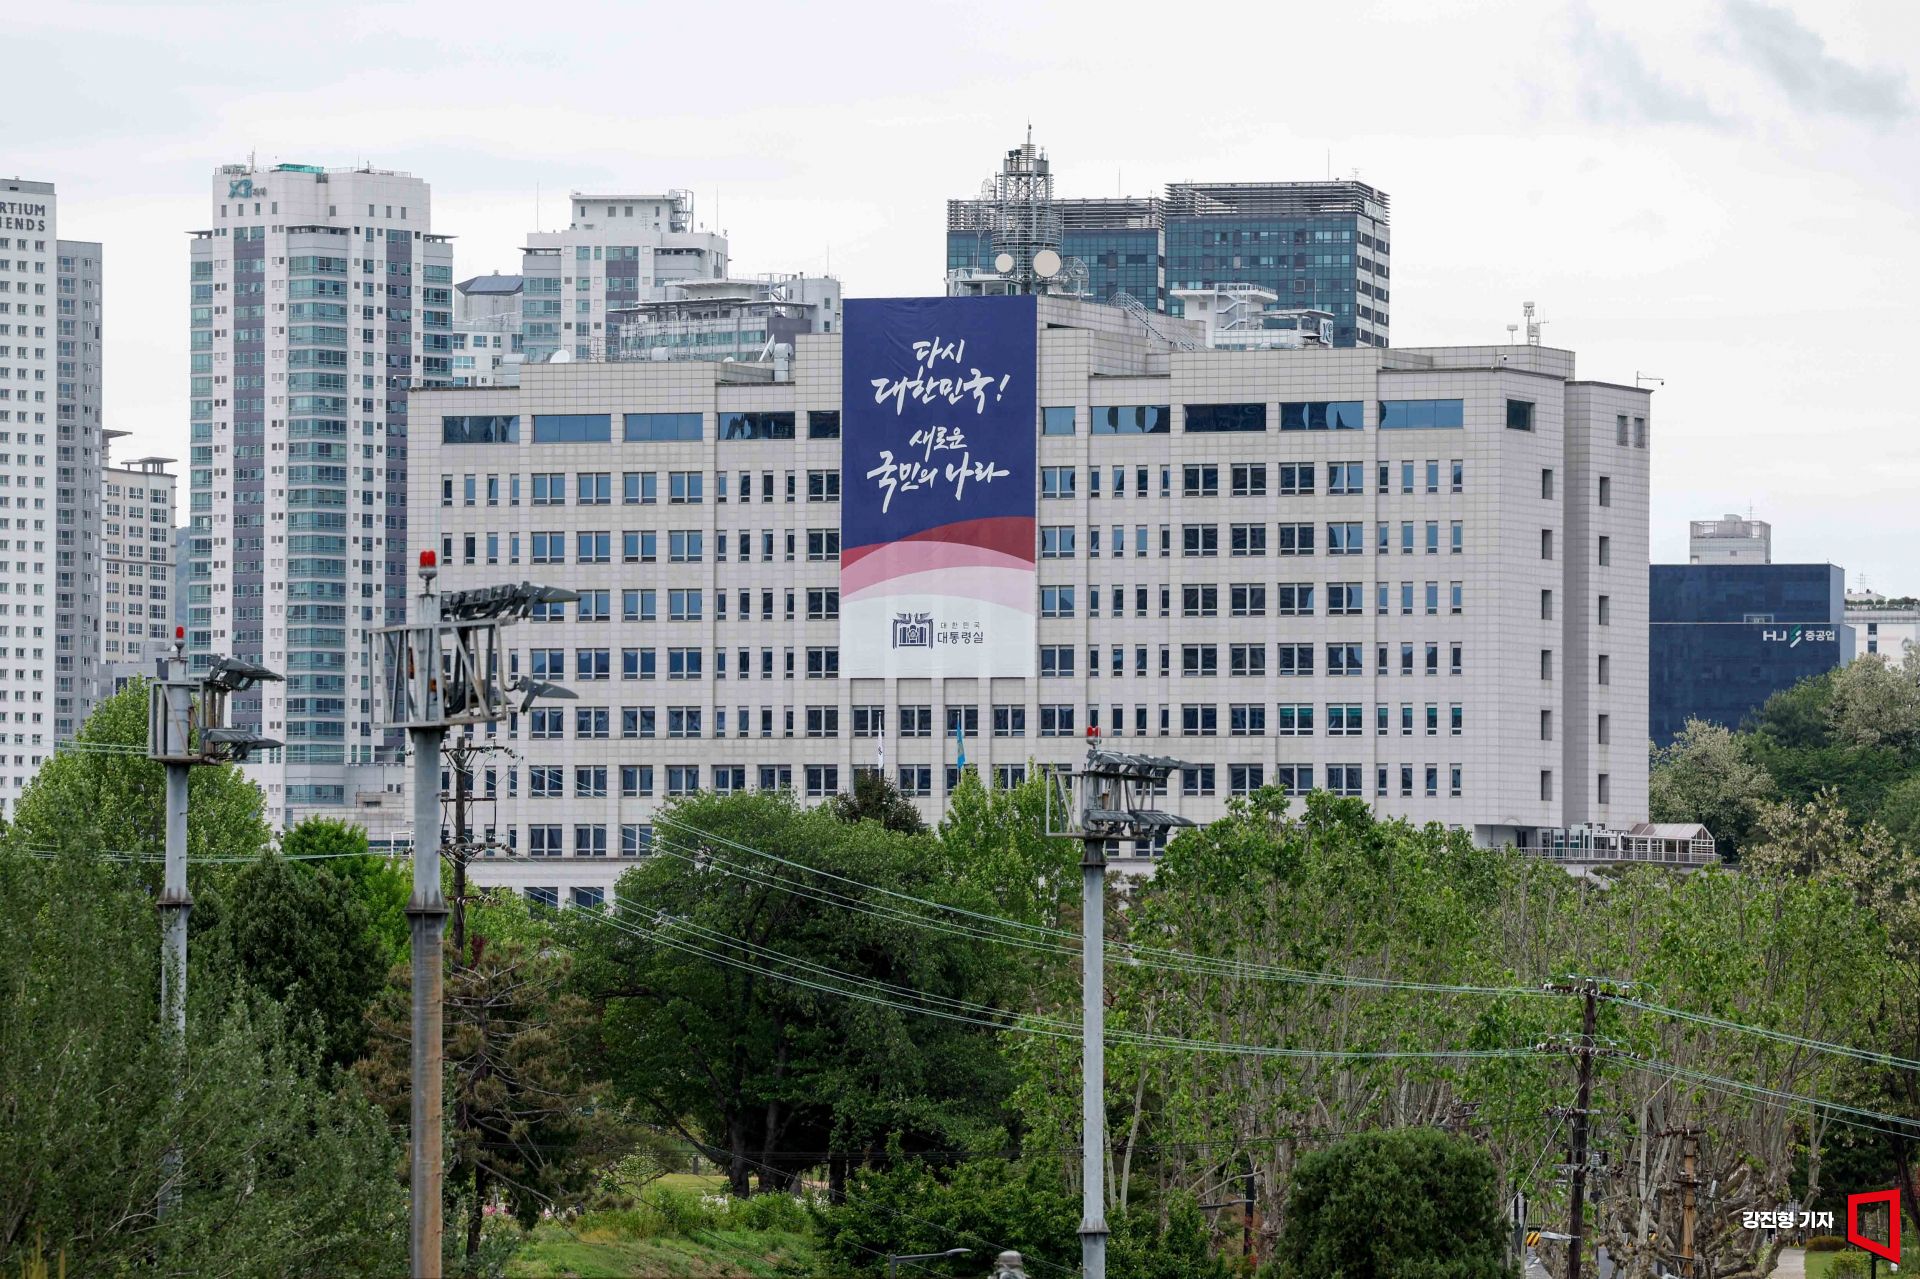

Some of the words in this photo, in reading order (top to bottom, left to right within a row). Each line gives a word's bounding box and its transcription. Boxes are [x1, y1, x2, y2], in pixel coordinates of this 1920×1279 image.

[0, 201, 46, 217] RTIUM
[912, 336, 965, 369] 다시
[871, 365, 1010, 415] 대한민국!
[909, 425, 968, 463] 새로운
[866, 450, 939, 514] 국민의
[945, 451, 1010, 501] 나라
[937, 631, 984, 645] 대통령실
[1762, 630, 1787, 641] HJ
[1805, 630, 1835, 641] 중공업
